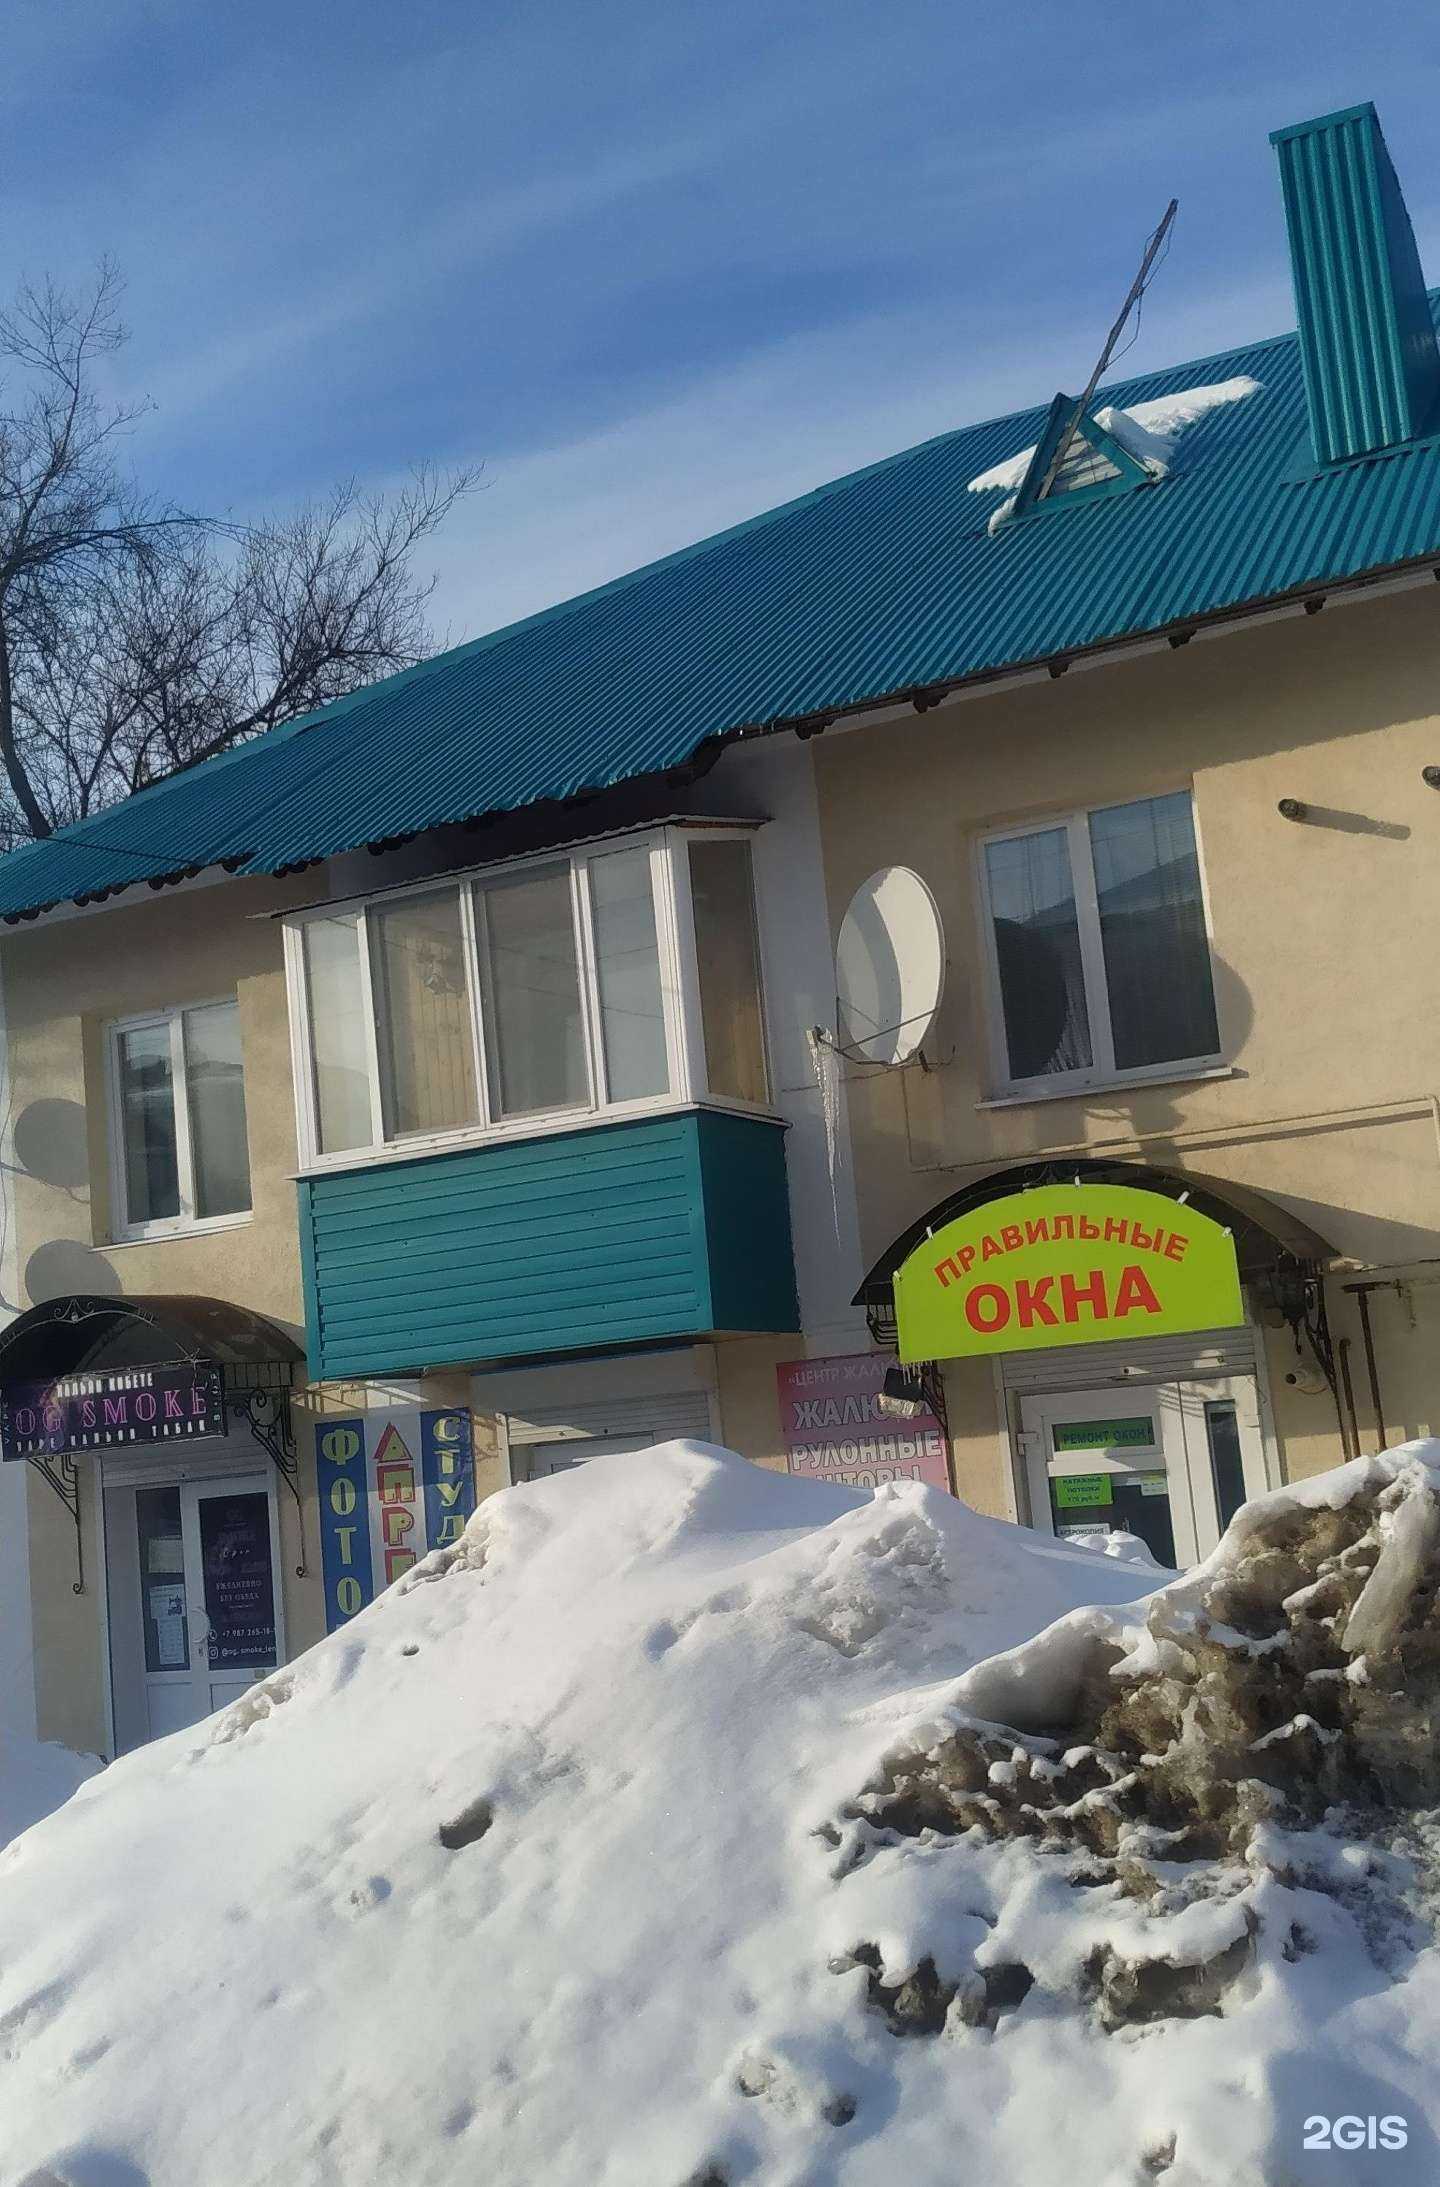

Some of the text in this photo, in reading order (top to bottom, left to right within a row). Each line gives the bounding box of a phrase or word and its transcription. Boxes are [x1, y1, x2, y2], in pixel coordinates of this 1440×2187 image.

[934, 1215, 1189, 1288] ПРАВИЛЬНЫЕ
[965, 1265, 1162, 1333] ОКНА
[83, 1386, 207, 1428] SMOKE
[791, 1430, 943, 1471] РУЛОННЫЕ
[321, 1428, 362, 1615] ФОТО
